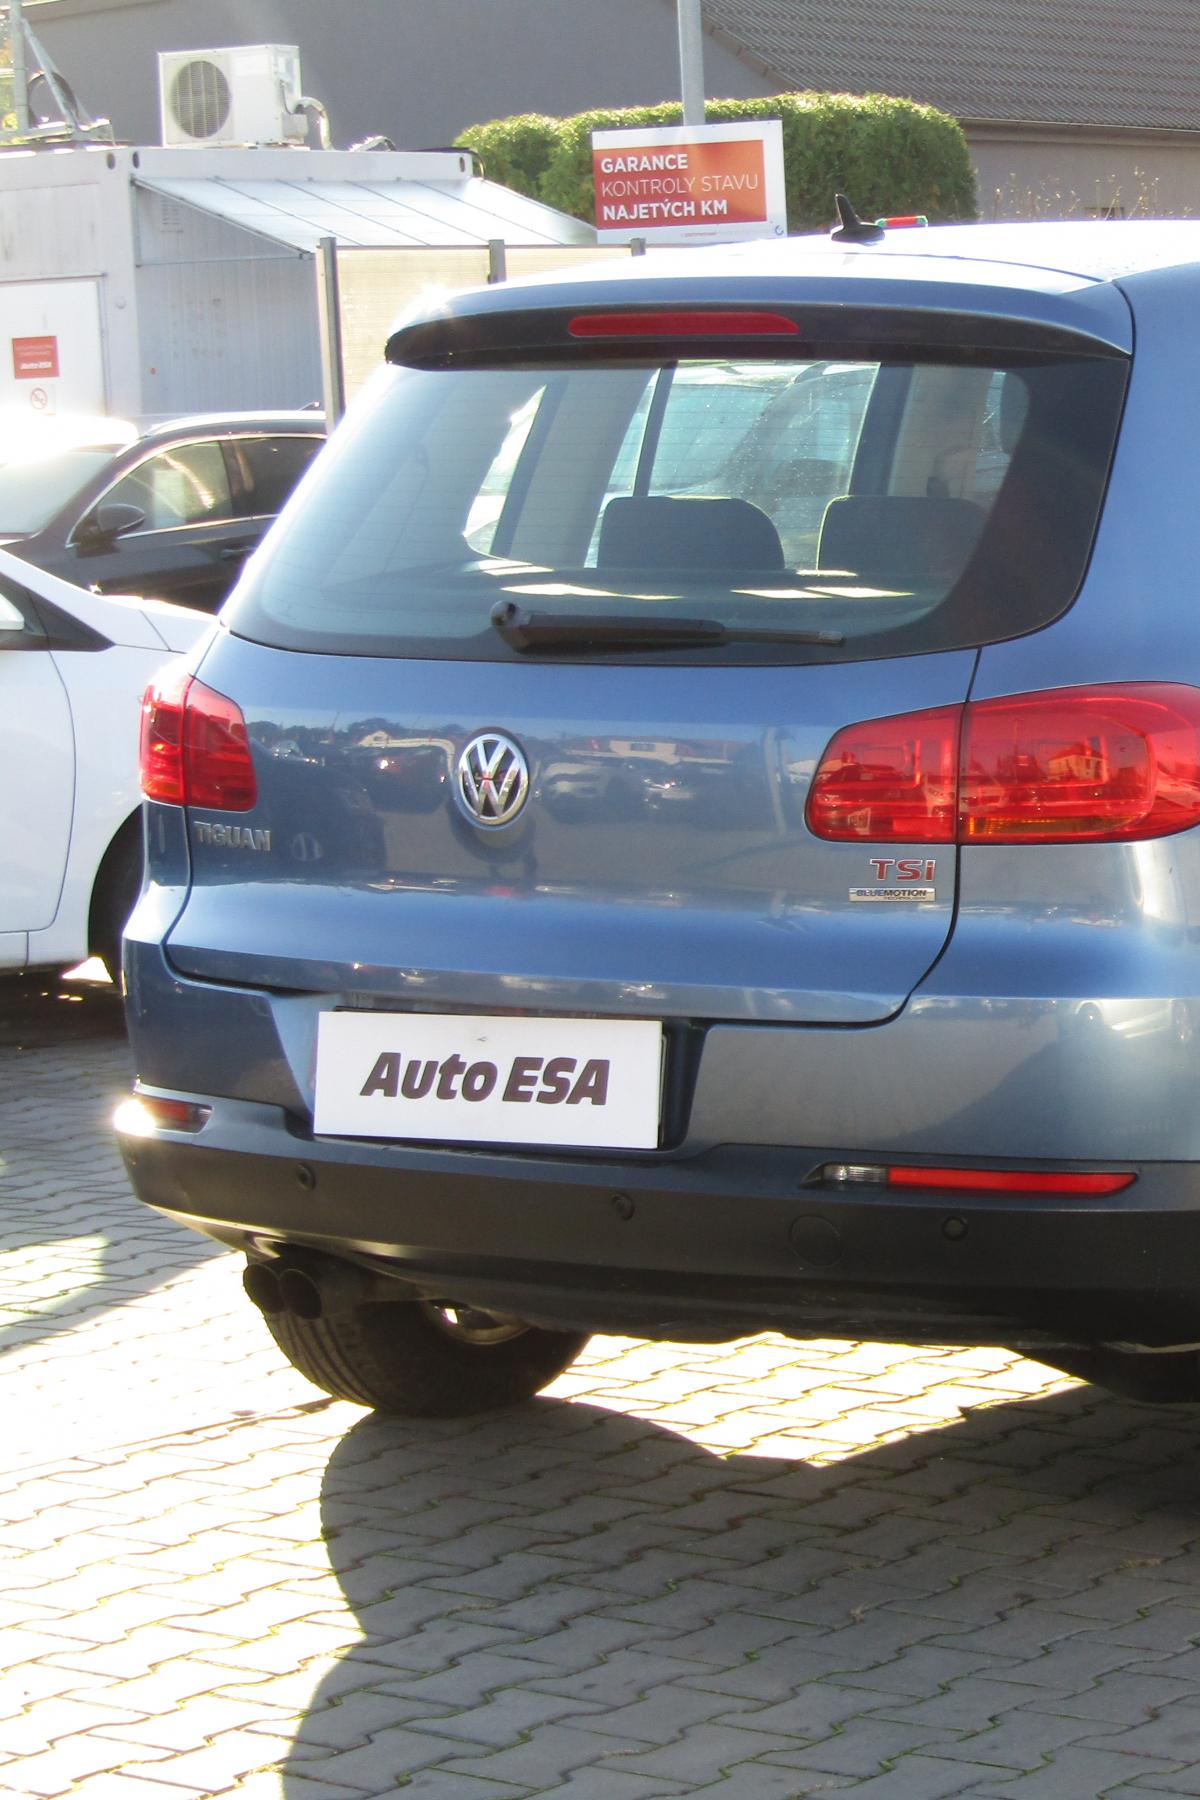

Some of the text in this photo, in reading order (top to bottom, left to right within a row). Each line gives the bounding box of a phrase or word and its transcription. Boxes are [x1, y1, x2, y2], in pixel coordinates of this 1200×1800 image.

[601, 153, 689, 174] GARANCE
[602, 174, 759, 198] KONTROLY STAVU
[602, 199, 728, 221] NAJETÝCH KM
[193, 821, 271, 851] TIGUAN
[856, 889, 928, 897] BLUEMOTION
[359, 1052, 611, 1105] Auto ESA
